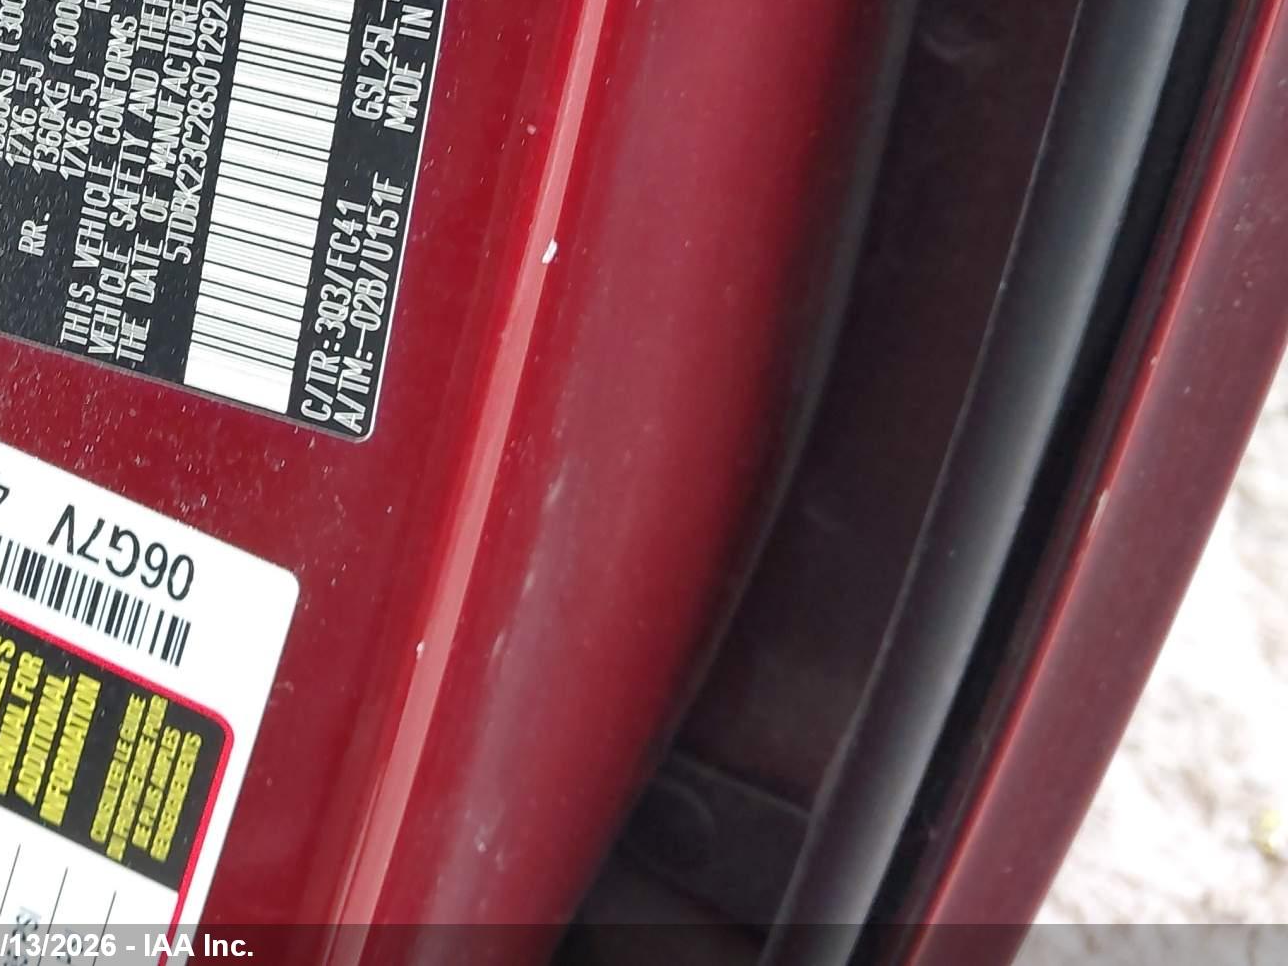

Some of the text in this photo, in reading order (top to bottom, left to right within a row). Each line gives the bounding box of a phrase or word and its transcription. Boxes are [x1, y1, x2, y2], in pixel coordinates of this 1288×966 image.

[399, 5, 434, 40] IN
[5, 58, 44, 167] 17X6.5J
[32, 79, 71, 174] 1360KG
[59, 69, 100, 181] 17X6.5J
[93, 14, 138, 145] CONFORMS
[127, 68, 159, 122] AND
[384, 56, 426, 133] MADE
[72, 155, 116, 268] VEHICLE
[108, 130, 150, 231] SAFETY
[140, 186, 169, 223] OF
[18, 213, 50, 256] RR.
[126, 233, 164, 303] DATE
[60, 282, 95, 346] THIS
[87, 241, 132, 354] VEHICLE
[115, 312, 151, 362] THE
[48, 504, 194, 601] 06G7V
[11, 651, 44, 702] FOR
[15, 674, 70, 805] ADDITIONAL
[39, 673, 101, 826] INFORMATION
